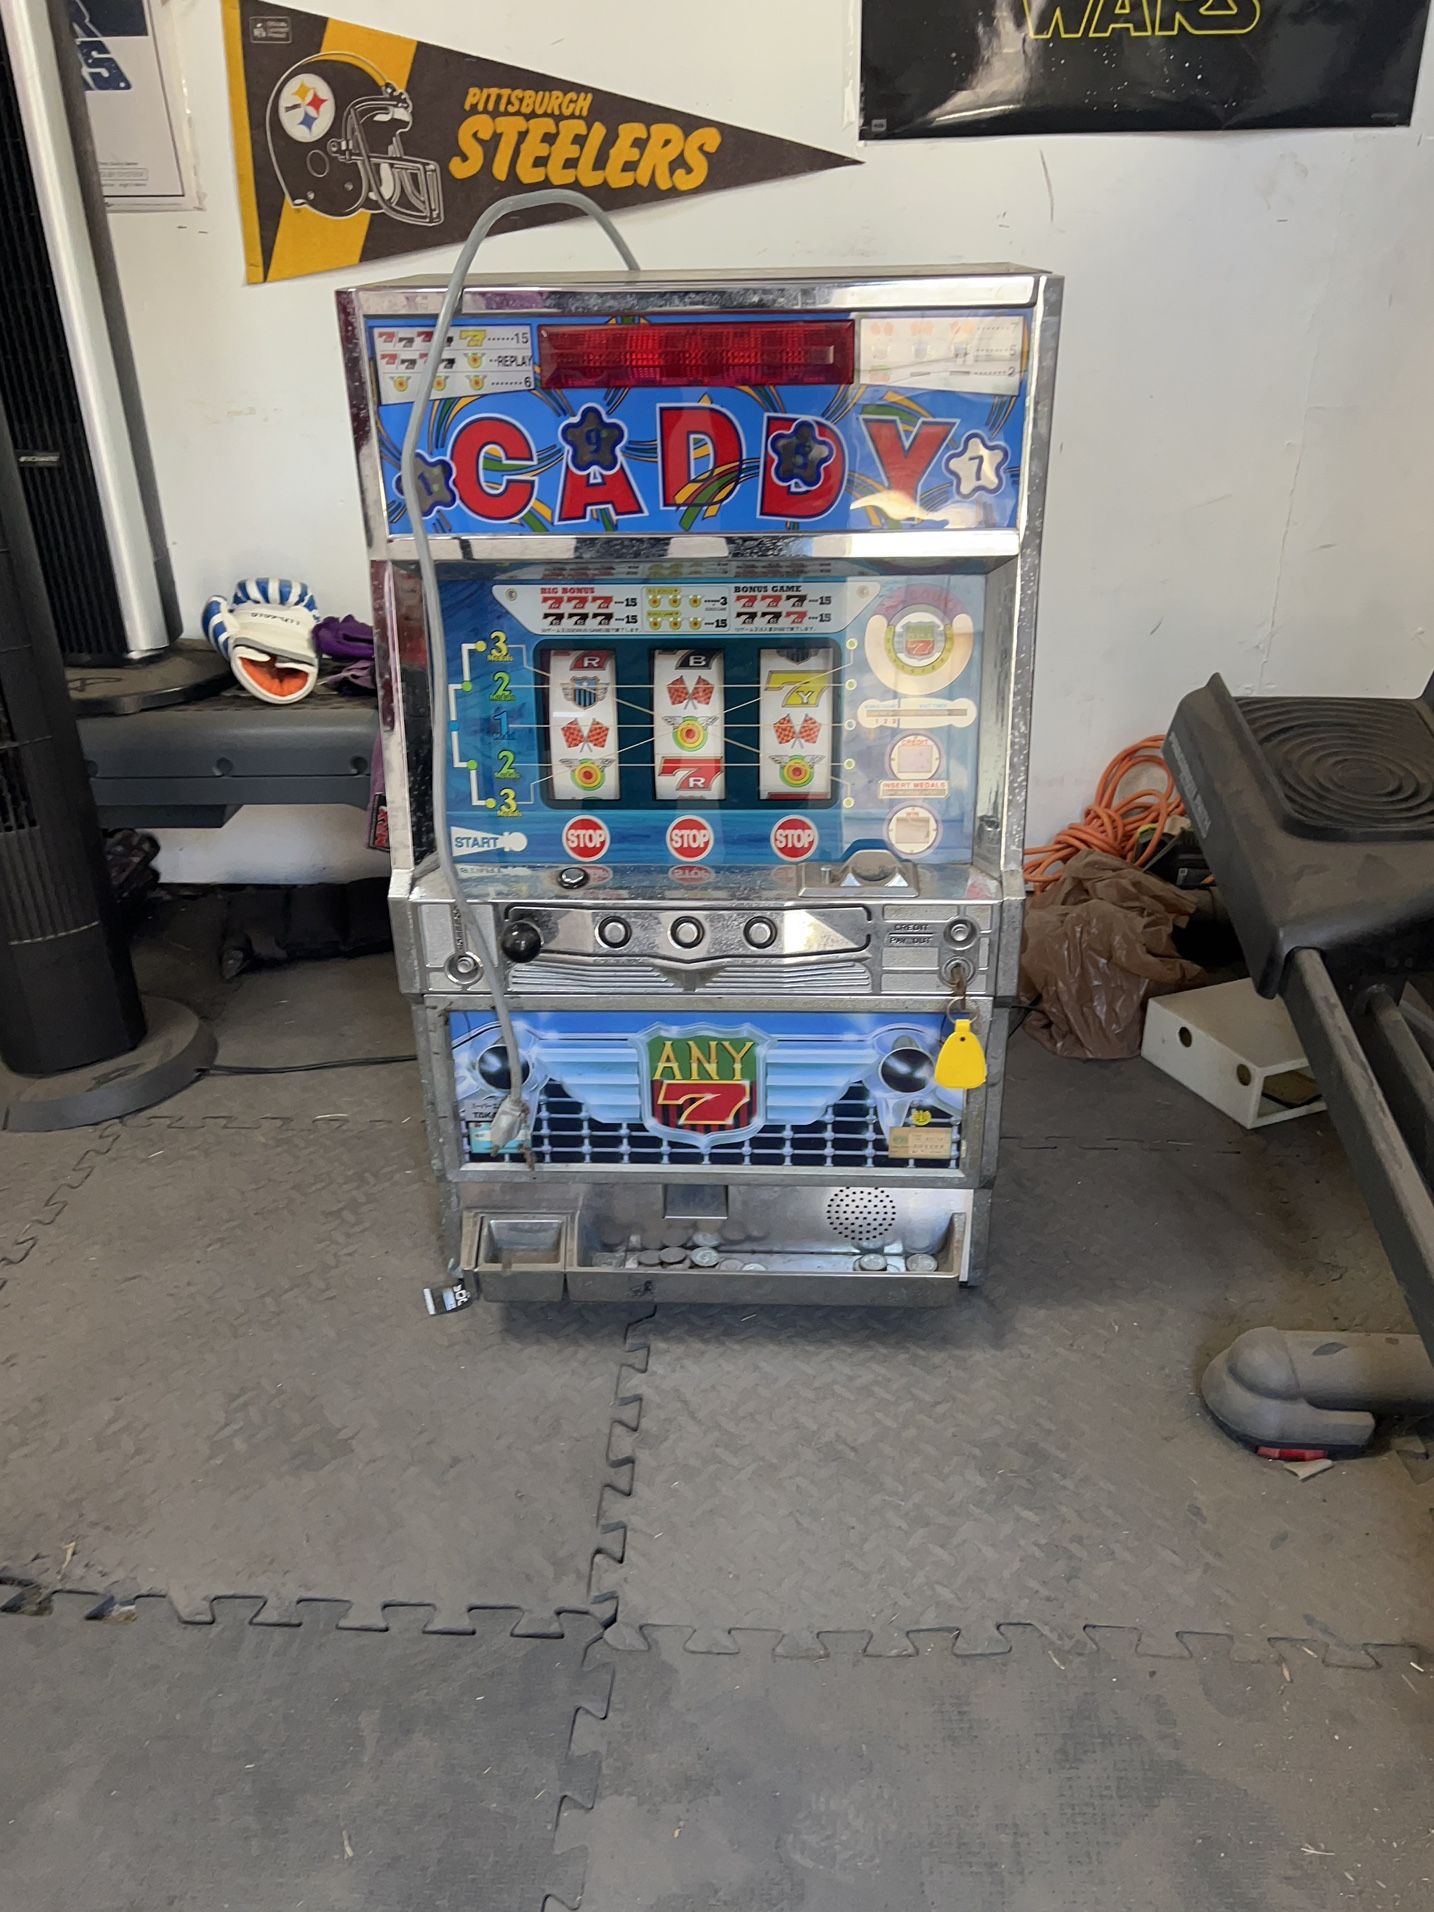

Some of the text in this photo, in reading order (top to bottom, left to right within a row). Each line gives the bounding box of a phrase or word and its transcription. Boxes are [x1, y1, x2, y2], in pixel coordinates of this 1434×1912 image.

[464, 87, 593, 117] PITTSBURGH
[449, 114, 722, 191] STEELERS
[515, 332, 529, 344] 15
[497, 355, 533, 368] REPLAY
[523, 377, 532, 388] 6
[450, 404, 962, 525] CADDY
[969, 456, 983, 479] 7
[771, 585, 802, 593] GAME
[625, 597, 638, 607] 15
[719, 596, 728, 606] 3
[819, 596, 832, 605] 15
[625, 615, 638, 624] 15
[715, 619, 728, 628] 15
[819, 613, 832, 622] 15
[490, 630, 508, 657] 3
[583, 656, 600, 668] R
[689, 655, 706, 667] B
[491, 671, 512, 698] 2
[493, 710, 508, 736] 1
[496, 749, 516, 776] 2
[657, 756, 723, 791] 7
[688, 777, 707, 788] R
[499, 787, 518, 812] 3
[455, 836, 499, 849] START
[567, 829, 606, 848] STOP
[670, 829, 709, 848] STOP
[774, 829, 814, 848] STOP
[894, 923, 929, 931] CREDIT
[911, 936, 931, 944] OUT
[652, 1040, 754, 1080] ANY
[657, 1079, 750, 1125] 7
